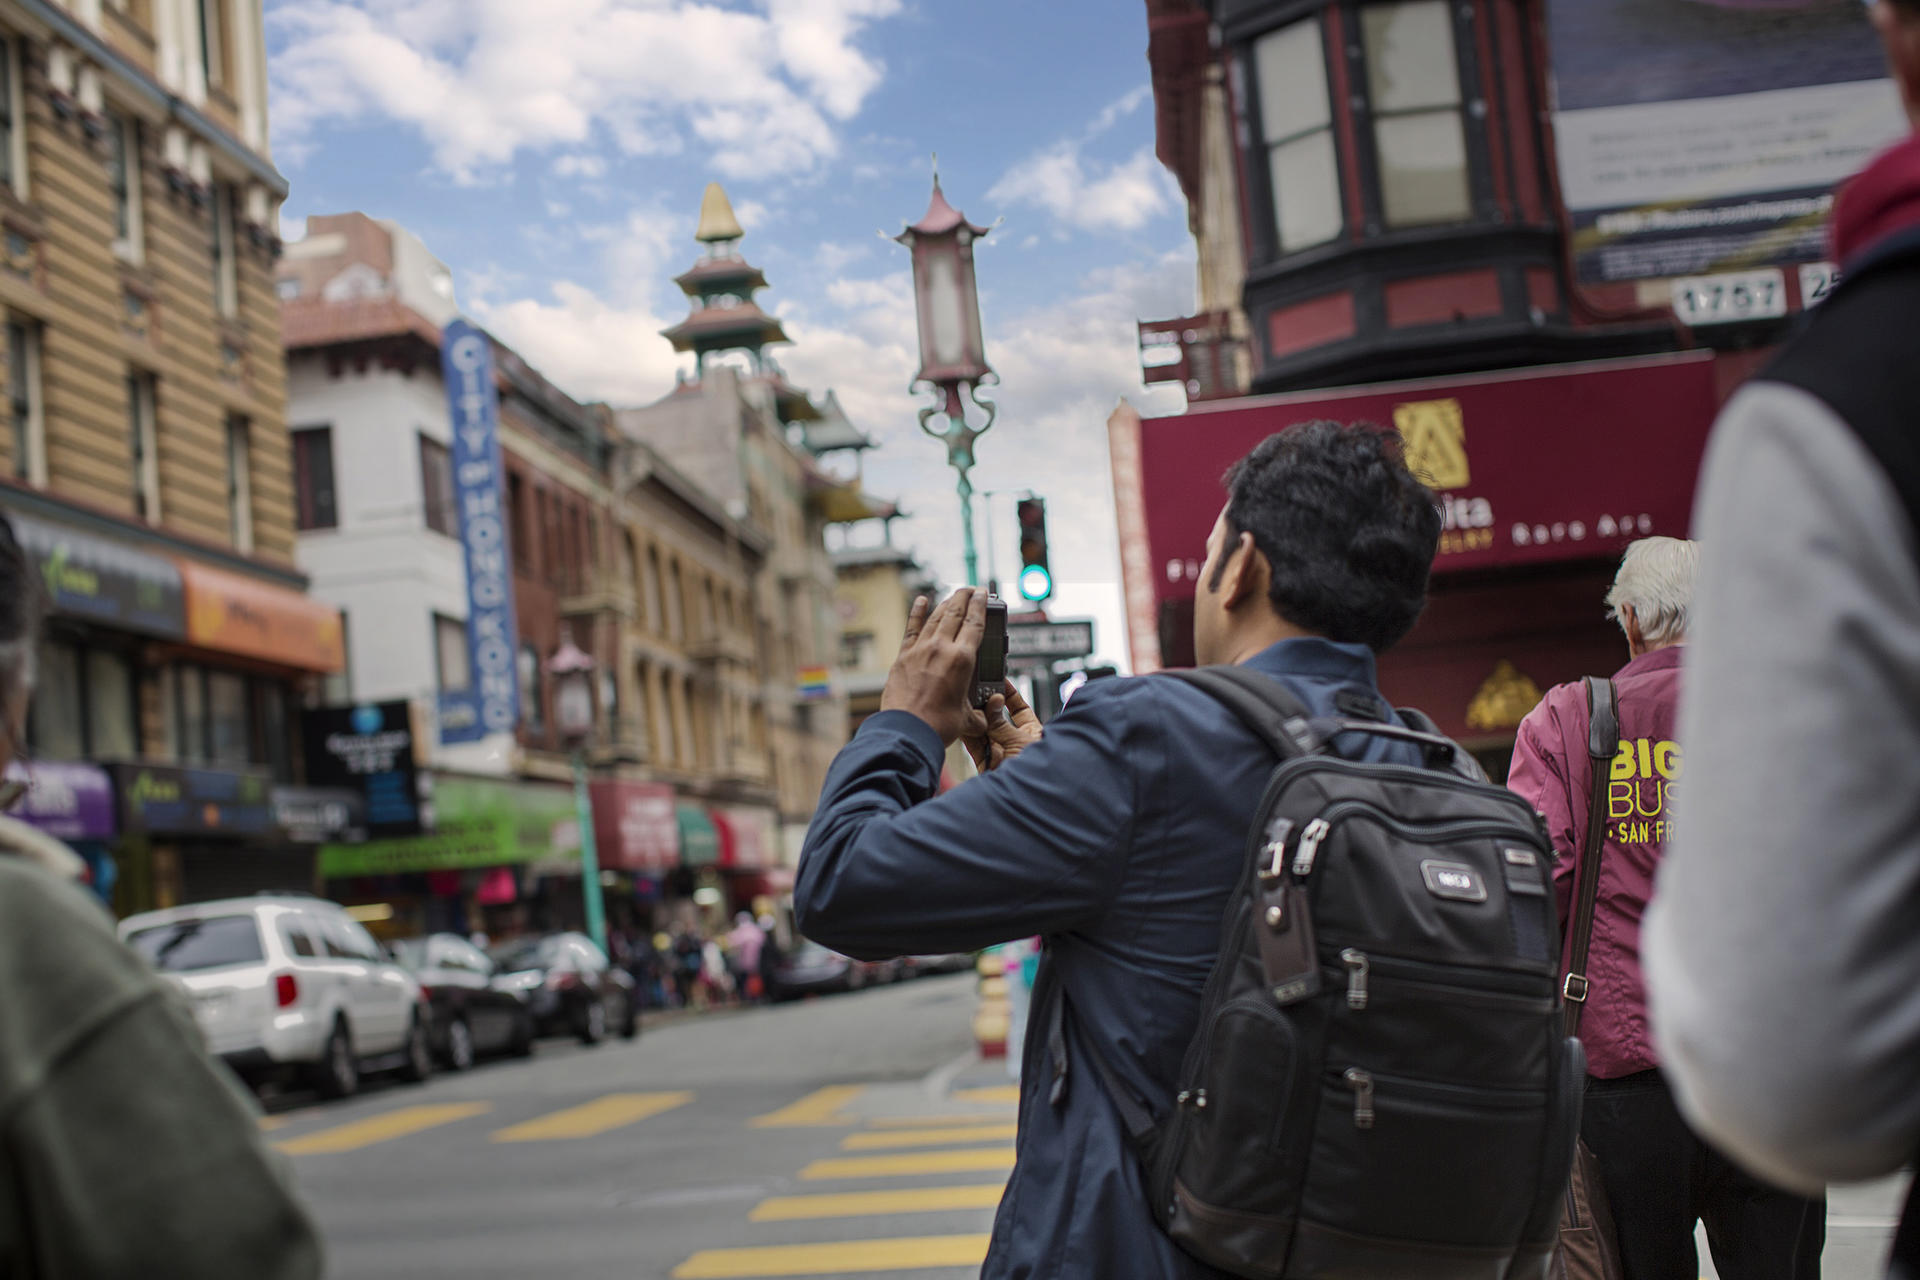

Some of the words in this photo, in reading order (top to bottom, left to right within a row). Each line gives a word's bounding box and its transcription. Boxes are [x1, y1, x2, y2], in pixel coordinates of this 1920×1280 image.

[451, 335, 488, 458] CITY
[465, 490, 505, 610] HONG
[475, 611, 513, 732] KONG
[1609, 738, 1684, 780] BIG
[1618, 821, 1649, 844] SAN
[1656, 820, 1679, 843] FR
